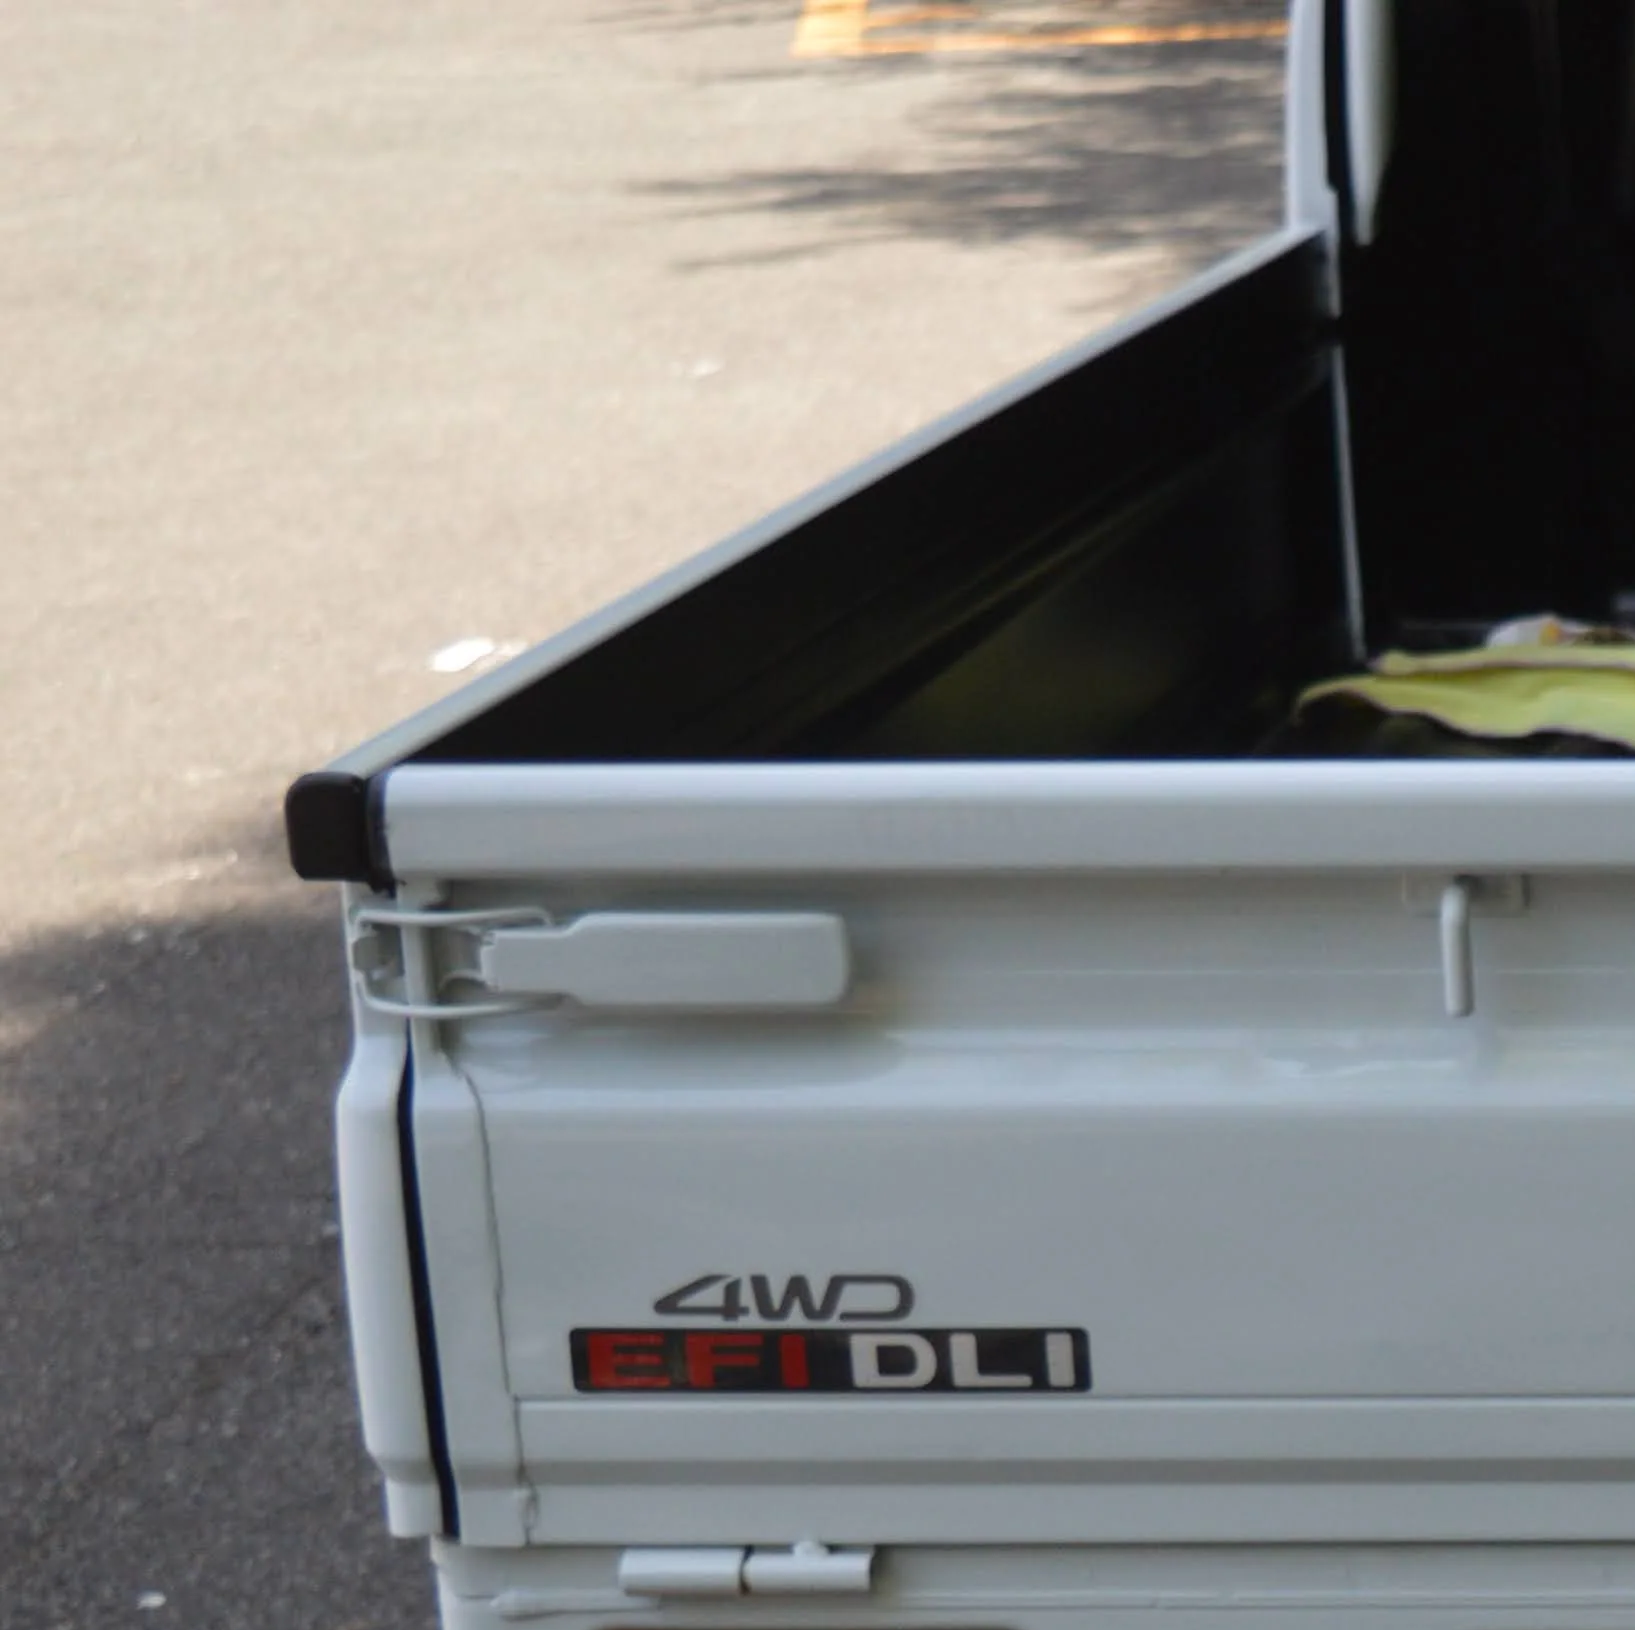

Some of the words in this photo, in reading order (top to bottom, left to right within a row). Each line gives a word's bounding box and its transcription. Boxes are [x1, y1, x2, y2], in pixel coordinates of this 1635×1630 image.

[652, 1274, 915, 1321] 4WD
[587, 1334, 811, 1387] EFI
[850, 1332, 1075, 1388] DLI
